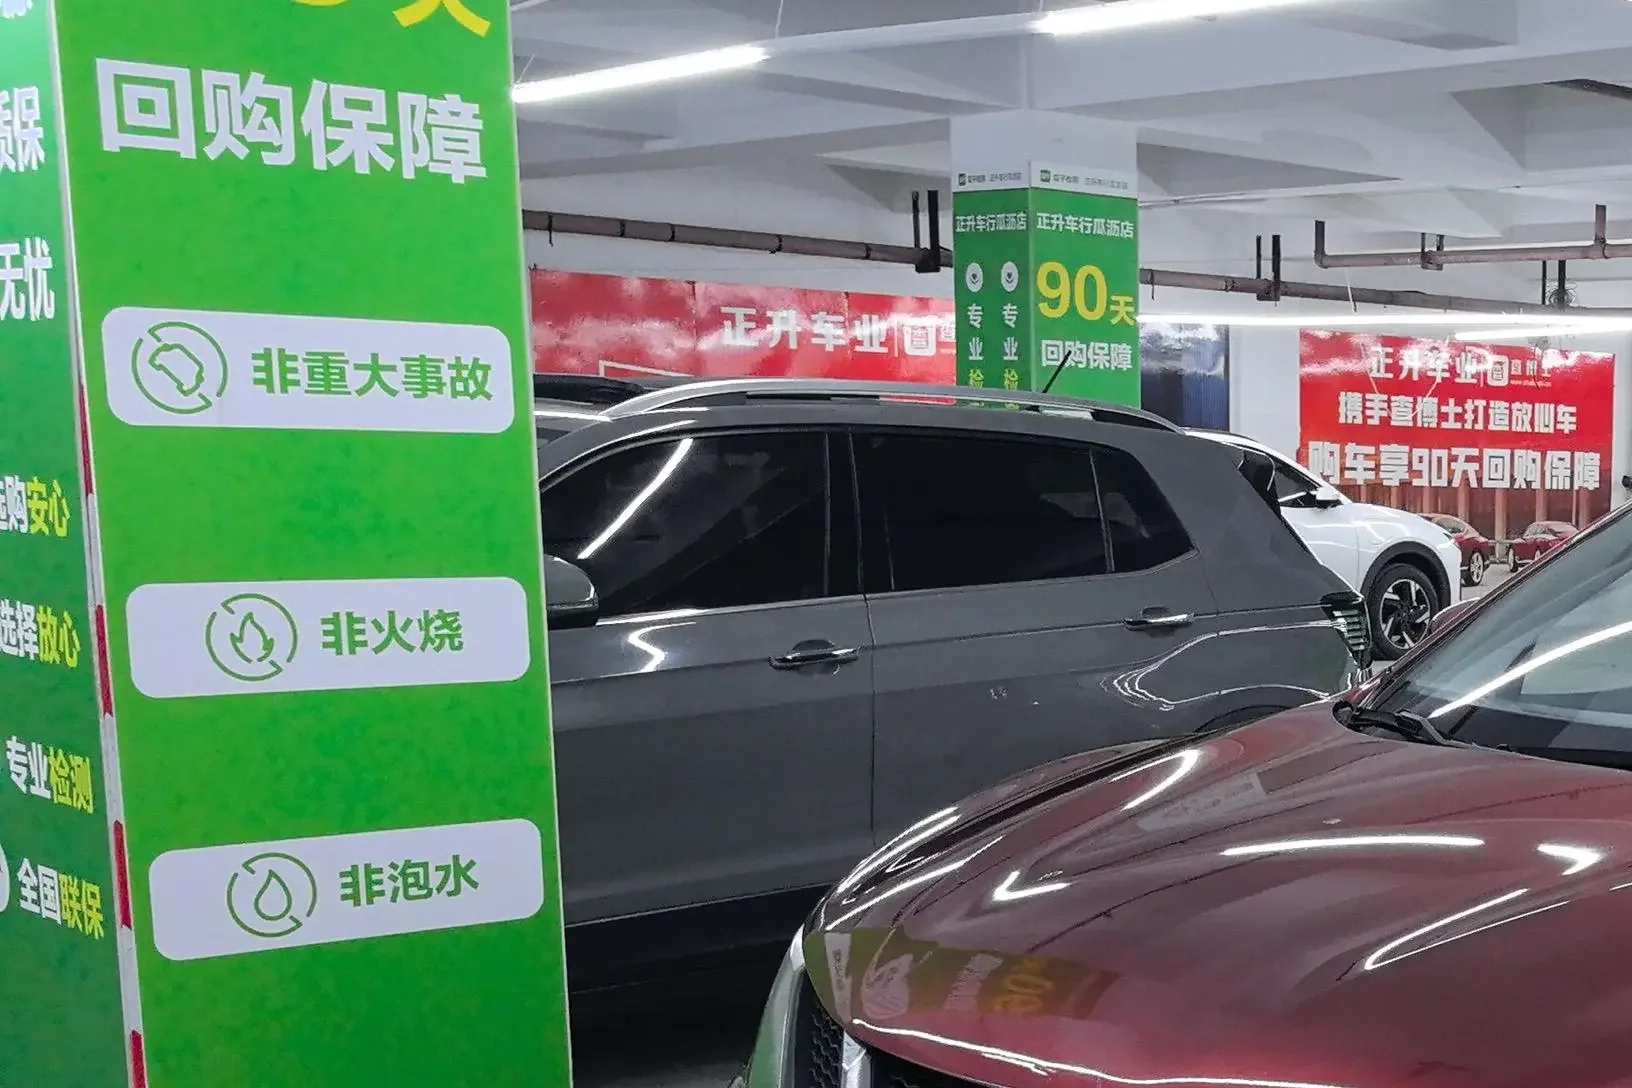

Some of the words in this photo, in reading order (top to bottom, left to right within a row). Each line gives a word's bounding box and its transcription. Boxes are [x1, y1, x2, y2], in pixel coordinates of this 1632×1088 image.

[96, 57, 488, 184] 回购保障
[955, 211, 1027, 233] 正升车行瓜沥店
[1036, 211, 1134, 239] 正升车行瓜沥店
[1037, 262, 1137, 326] 90天
[719, 305, 888, 354] 正升车业
[1041, 340, 1133, 371] 回购保障
[251, 346, 494, 402] 非重大事故
[1338, 391, 1577, 434] 携手查博士打造放心车
[1308, 440, 1601, 491] 购车享90天回购保障
[0, 598, 81, 668] 选择放心
[320, 608, 465, 656] 非火烧
[5, 735, 94, 814] 专业检测
[16, 857, 105, 940] 全国联保
[339, 854, 480, 908] 非泡水
